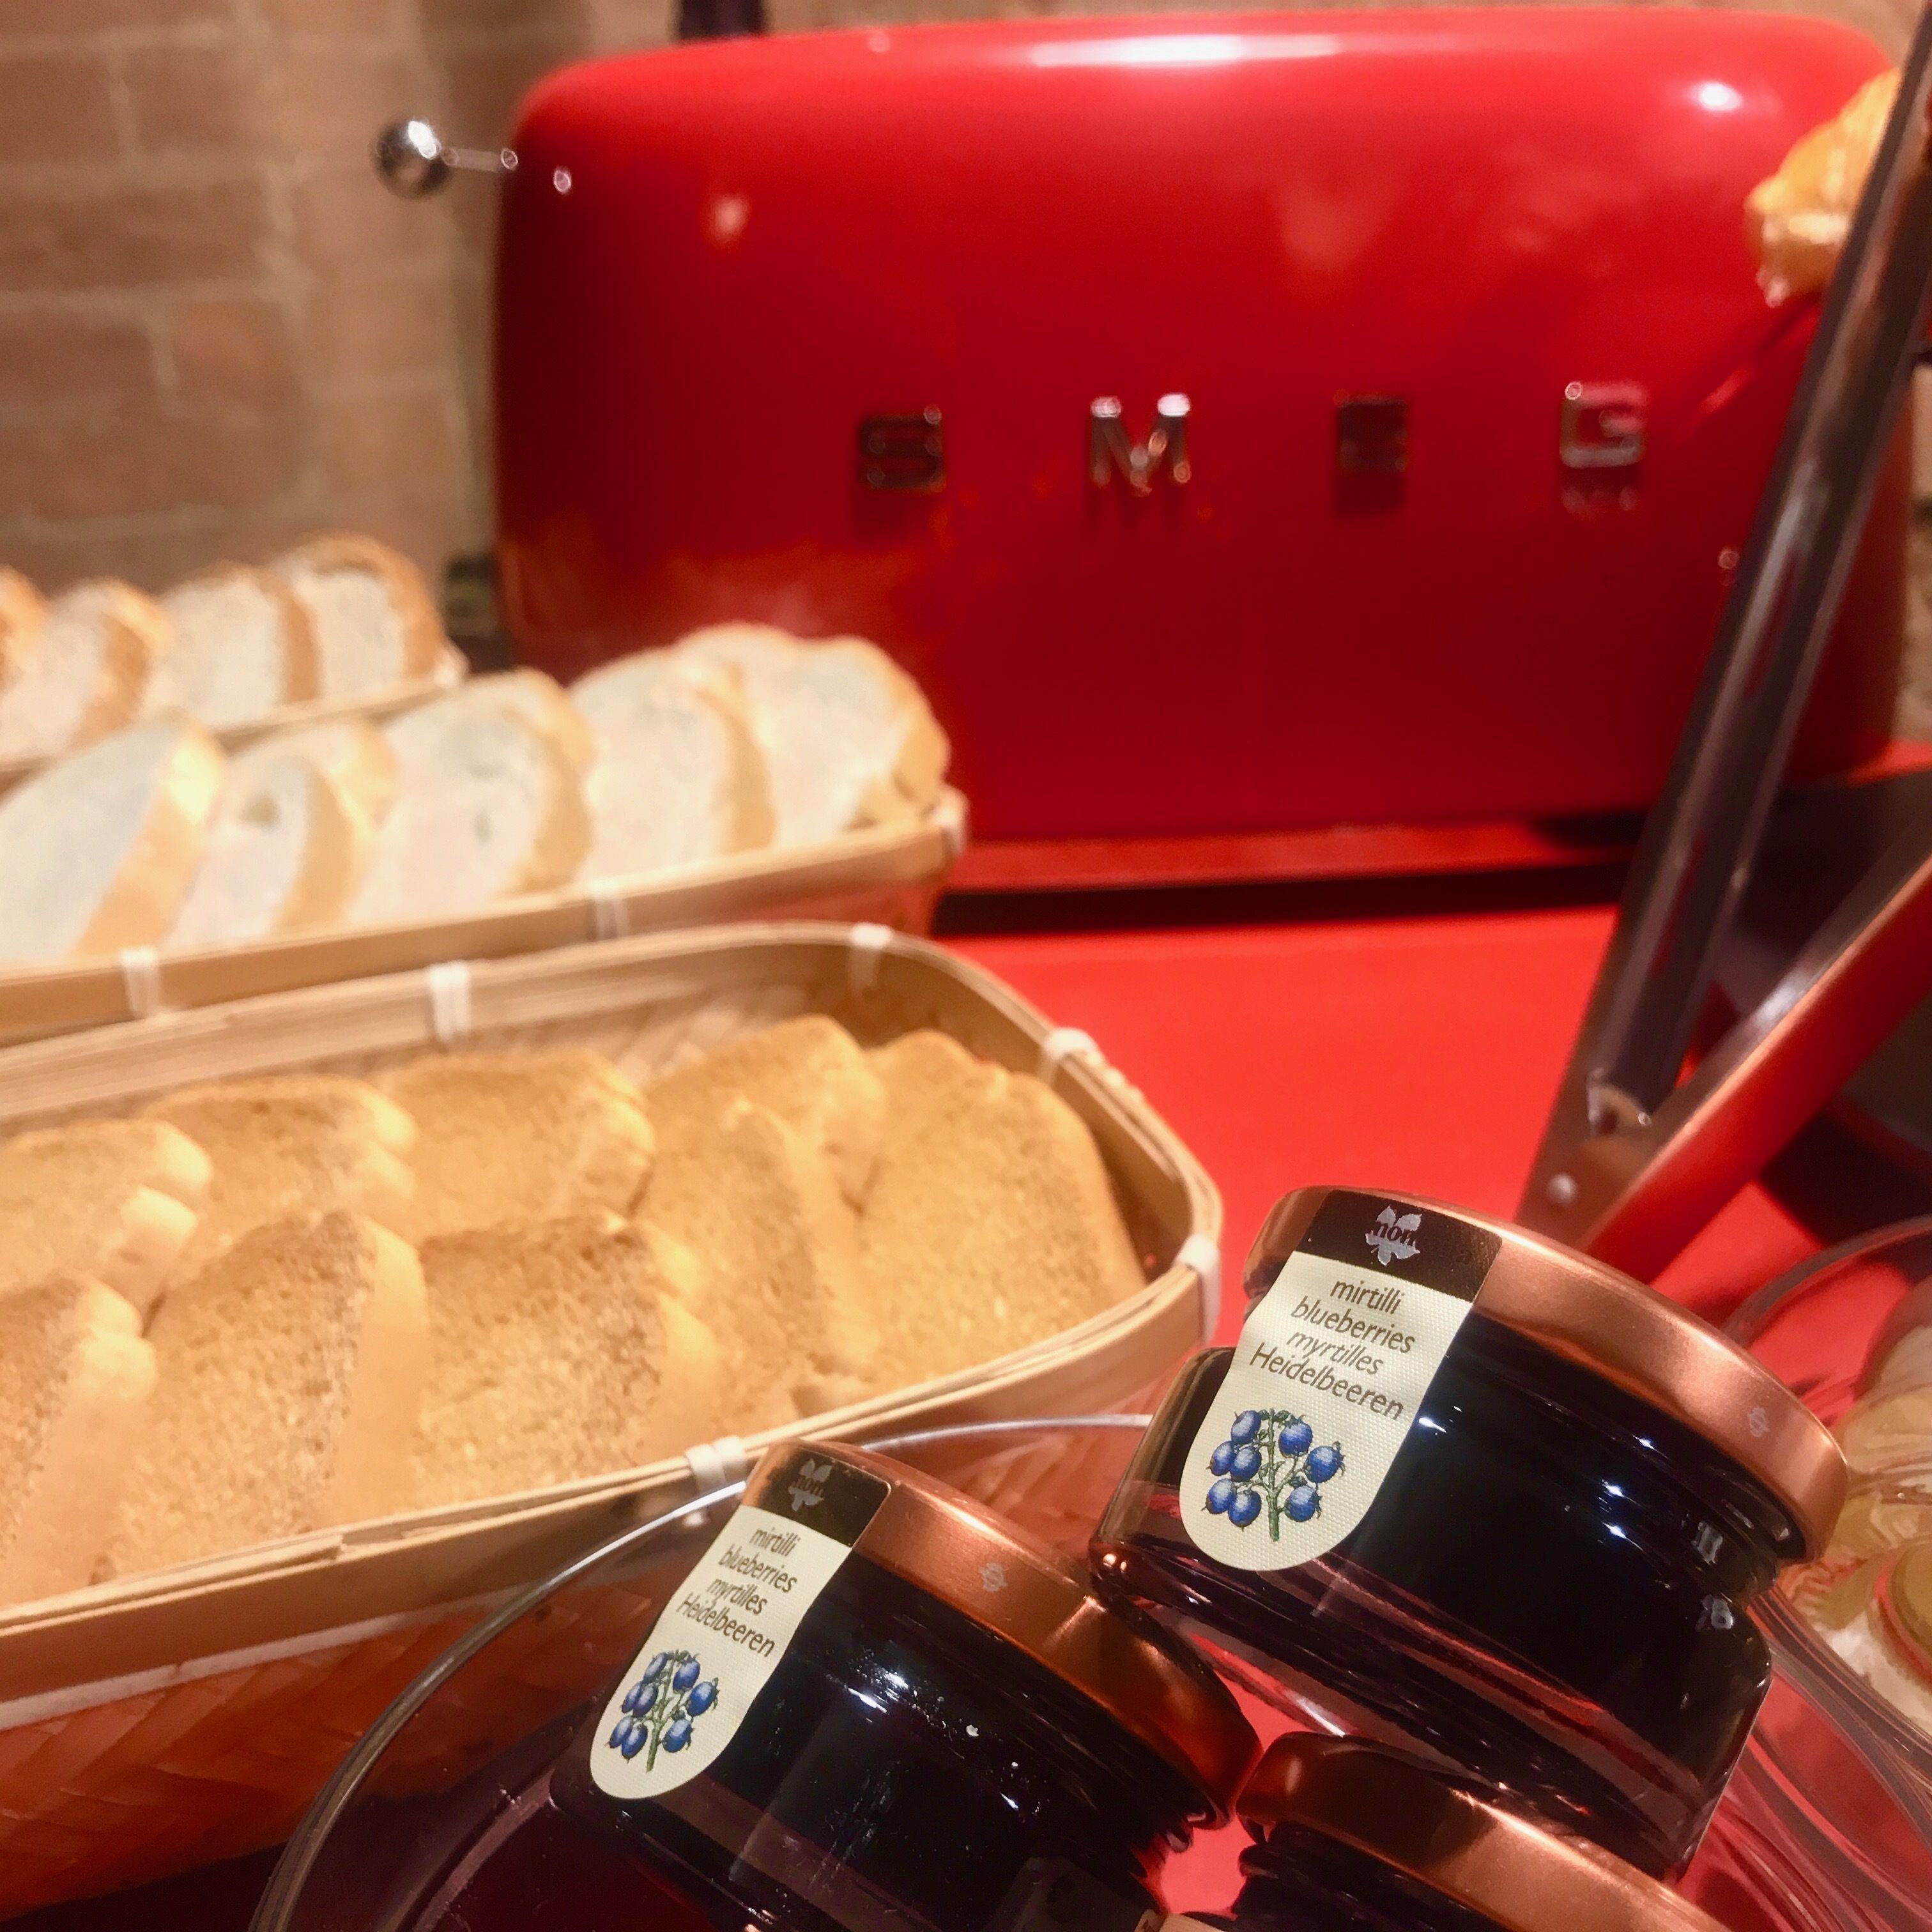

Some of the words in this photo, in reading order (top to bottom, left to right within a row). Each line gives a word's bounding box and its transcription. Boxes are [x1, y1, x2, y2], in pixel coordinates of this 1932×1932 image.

[1330, 1280, 1406, 1314] mirtilli
[1291, 1296, 1415, 1353] blueberries
[1287, 1332, 1384, 1375] myrtilles
[1249, 1342, 1404, 1420] Heidelbeeren
[749, 1527, 801, 1556] mirtilli
[718, 1544, 797, 1593] blueberries
[707, 1578, 768, 1615] myrtilles
[676, 1591, 776, 1657] Heidelbeeren
